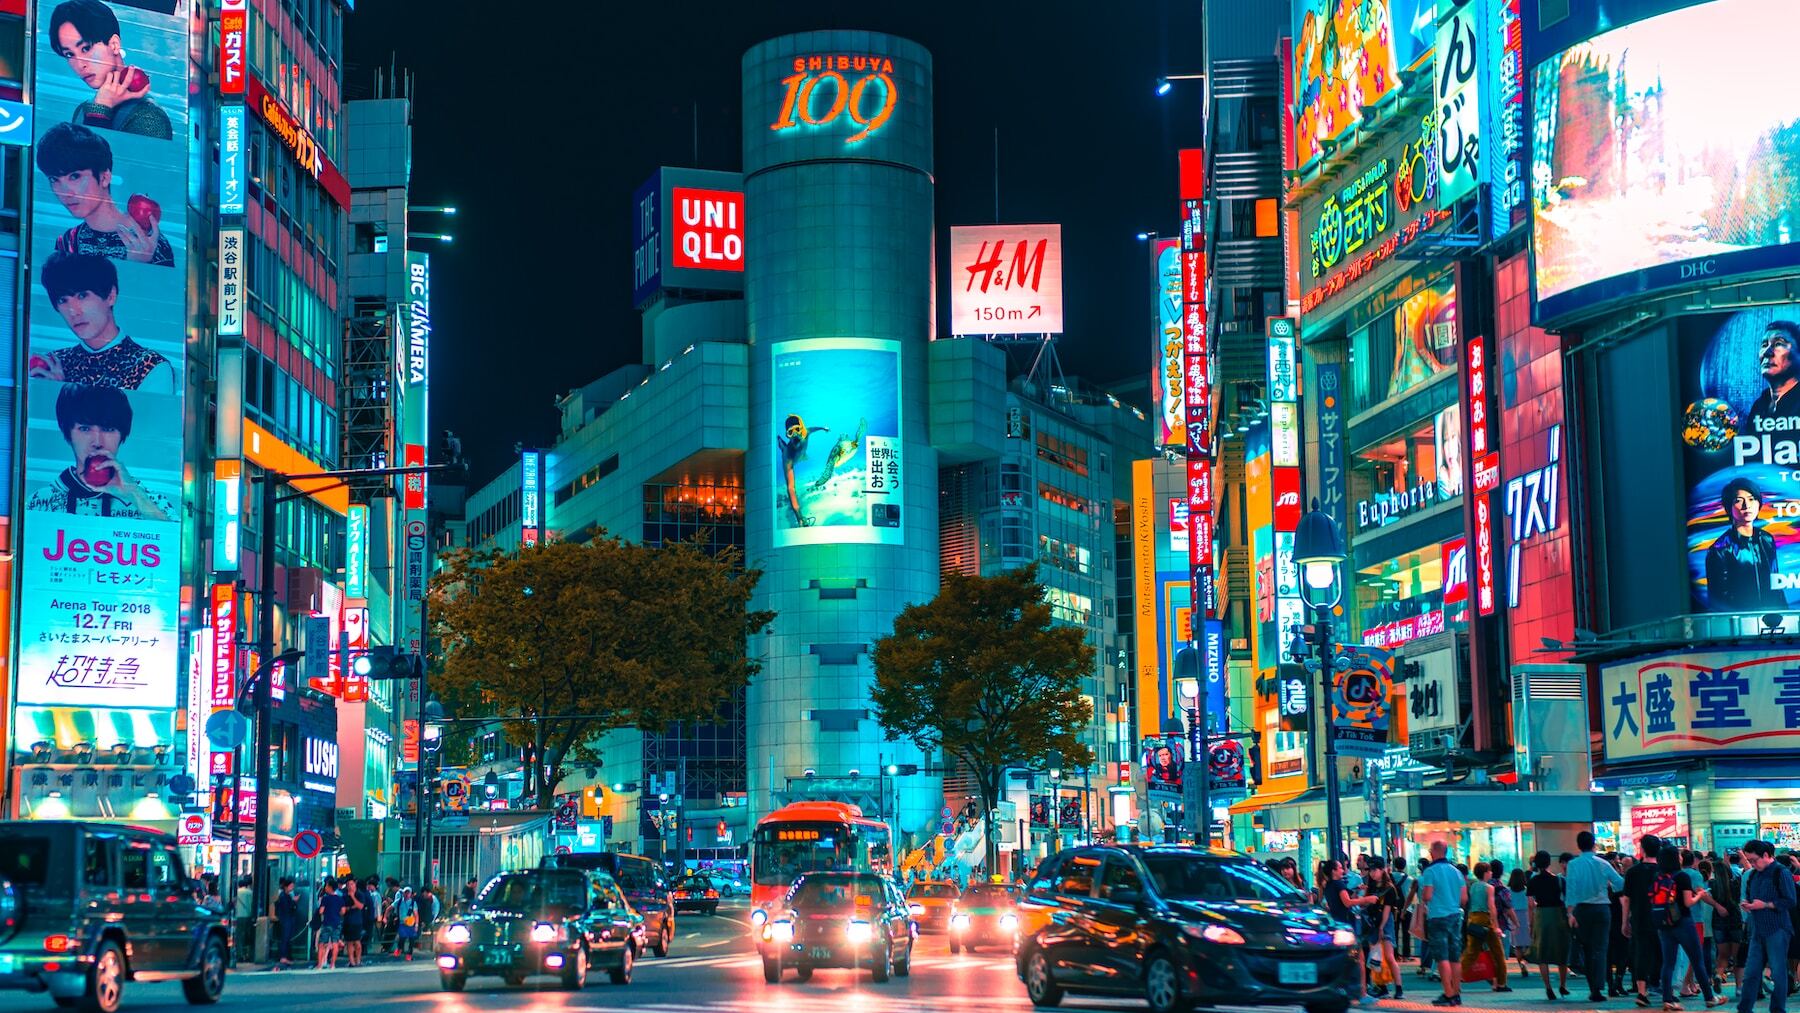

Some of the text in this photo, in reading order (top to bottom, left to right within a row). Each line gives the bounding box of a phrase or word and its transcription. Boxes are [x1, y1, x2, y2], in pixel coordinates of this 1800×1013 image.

[225, 31, 241, 83] ガスト
[793, 55, 893, 73] SHIBUYA
[770, 70, 897, 142] 109
[226, 117, 240, 204] 英会話イーオン
[640, 191, 655, 241] THE
[682, 198, 736, 230] UNI
[1344, 179, 1388, 255] 西村
[634, 232, 660, 291] PRIME
[682, 231, 742, 263] QLO
[223, 236, 238, 327] 渋谷駅前ビル
[410, 263, 425, 296] BIC
[966, 239, 1047, 294] H&M
[1681, 260, 1716, 278] DHC
[974, 306, 1022, 321] 150m
[1191, 408, 1203, 416] 6F
[870, 447, 899, 460] 世界に
[1734, 434, 1800, 466] Pla
[1276, 492, 1298, 507] JTB
[1358, 475, 1434, 527] Euphoria
[43, 529, 161, 568] Jesus
[112, 530, 161, 541] NEW SINGLE
[50, 598, 151, 614] Arena Tour 2018
[73, 613, 133, 631] 12.7 FRI
[39, 632, 160, 648] さいたまスーパーアリーナ
[215, 618, 232, 699] サンドラッグ
[1208, 633, 1219, 683] MIZUHO
[1345, 731, 1375, 741] Tik Tok
[305, 737, 338, 779] LUSH
[1620, 776, 1649, 785] TAISEIDO
